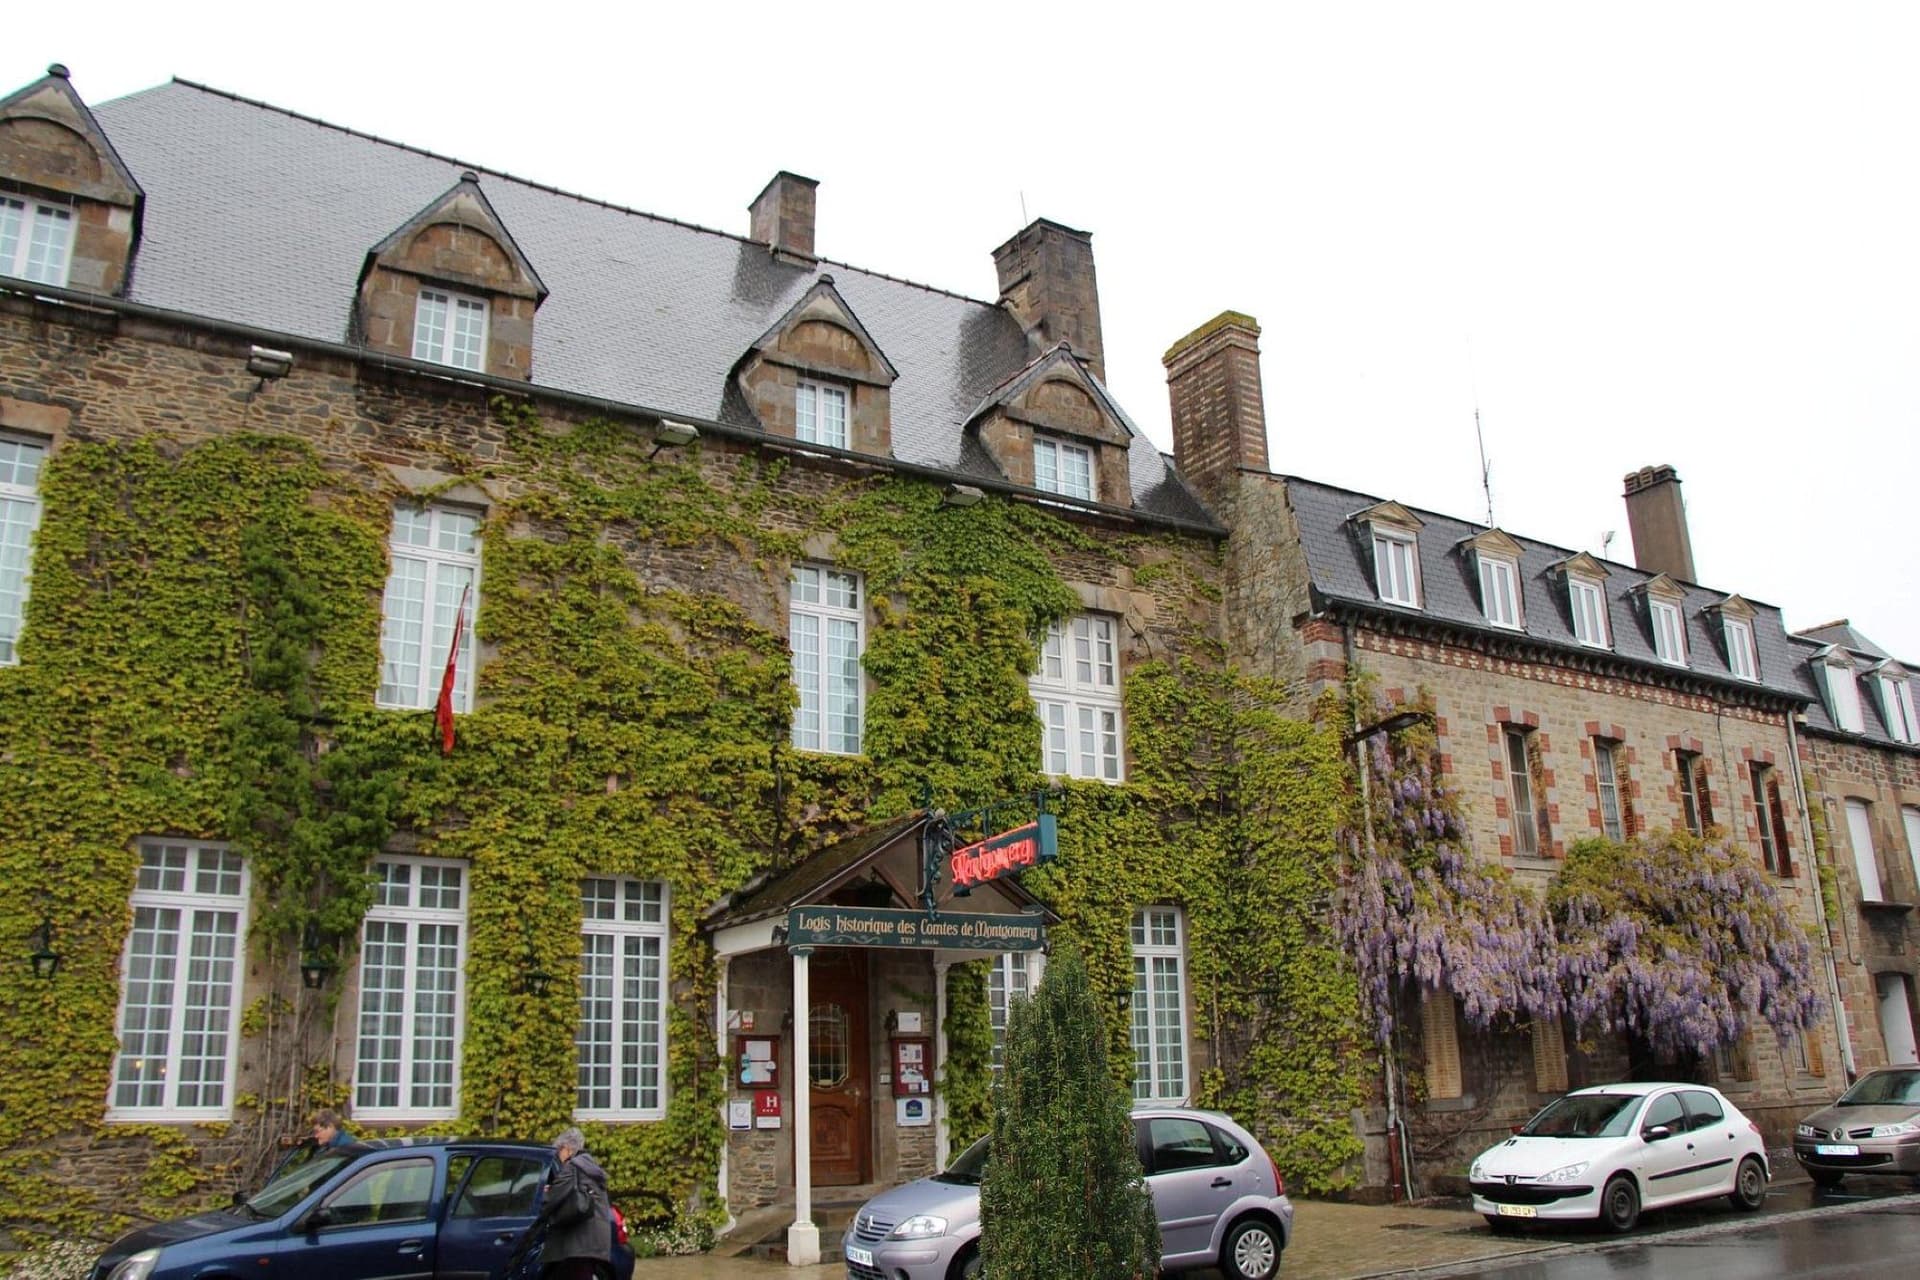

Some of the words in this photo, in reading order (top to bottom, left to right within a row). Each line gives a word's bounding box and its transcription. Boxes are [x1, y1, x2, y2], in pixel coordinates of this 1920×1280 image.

[799, 913, 831, 932] Logis
[836, 914, 894, 935] historique
[897, 919, 916, 935] des
[920, 918, 959, 936] Comtes
[961, 921, 973, 936] de
[974, 920, 1038, 940] Montgomery
[766, 1095, 778, 1108] H
